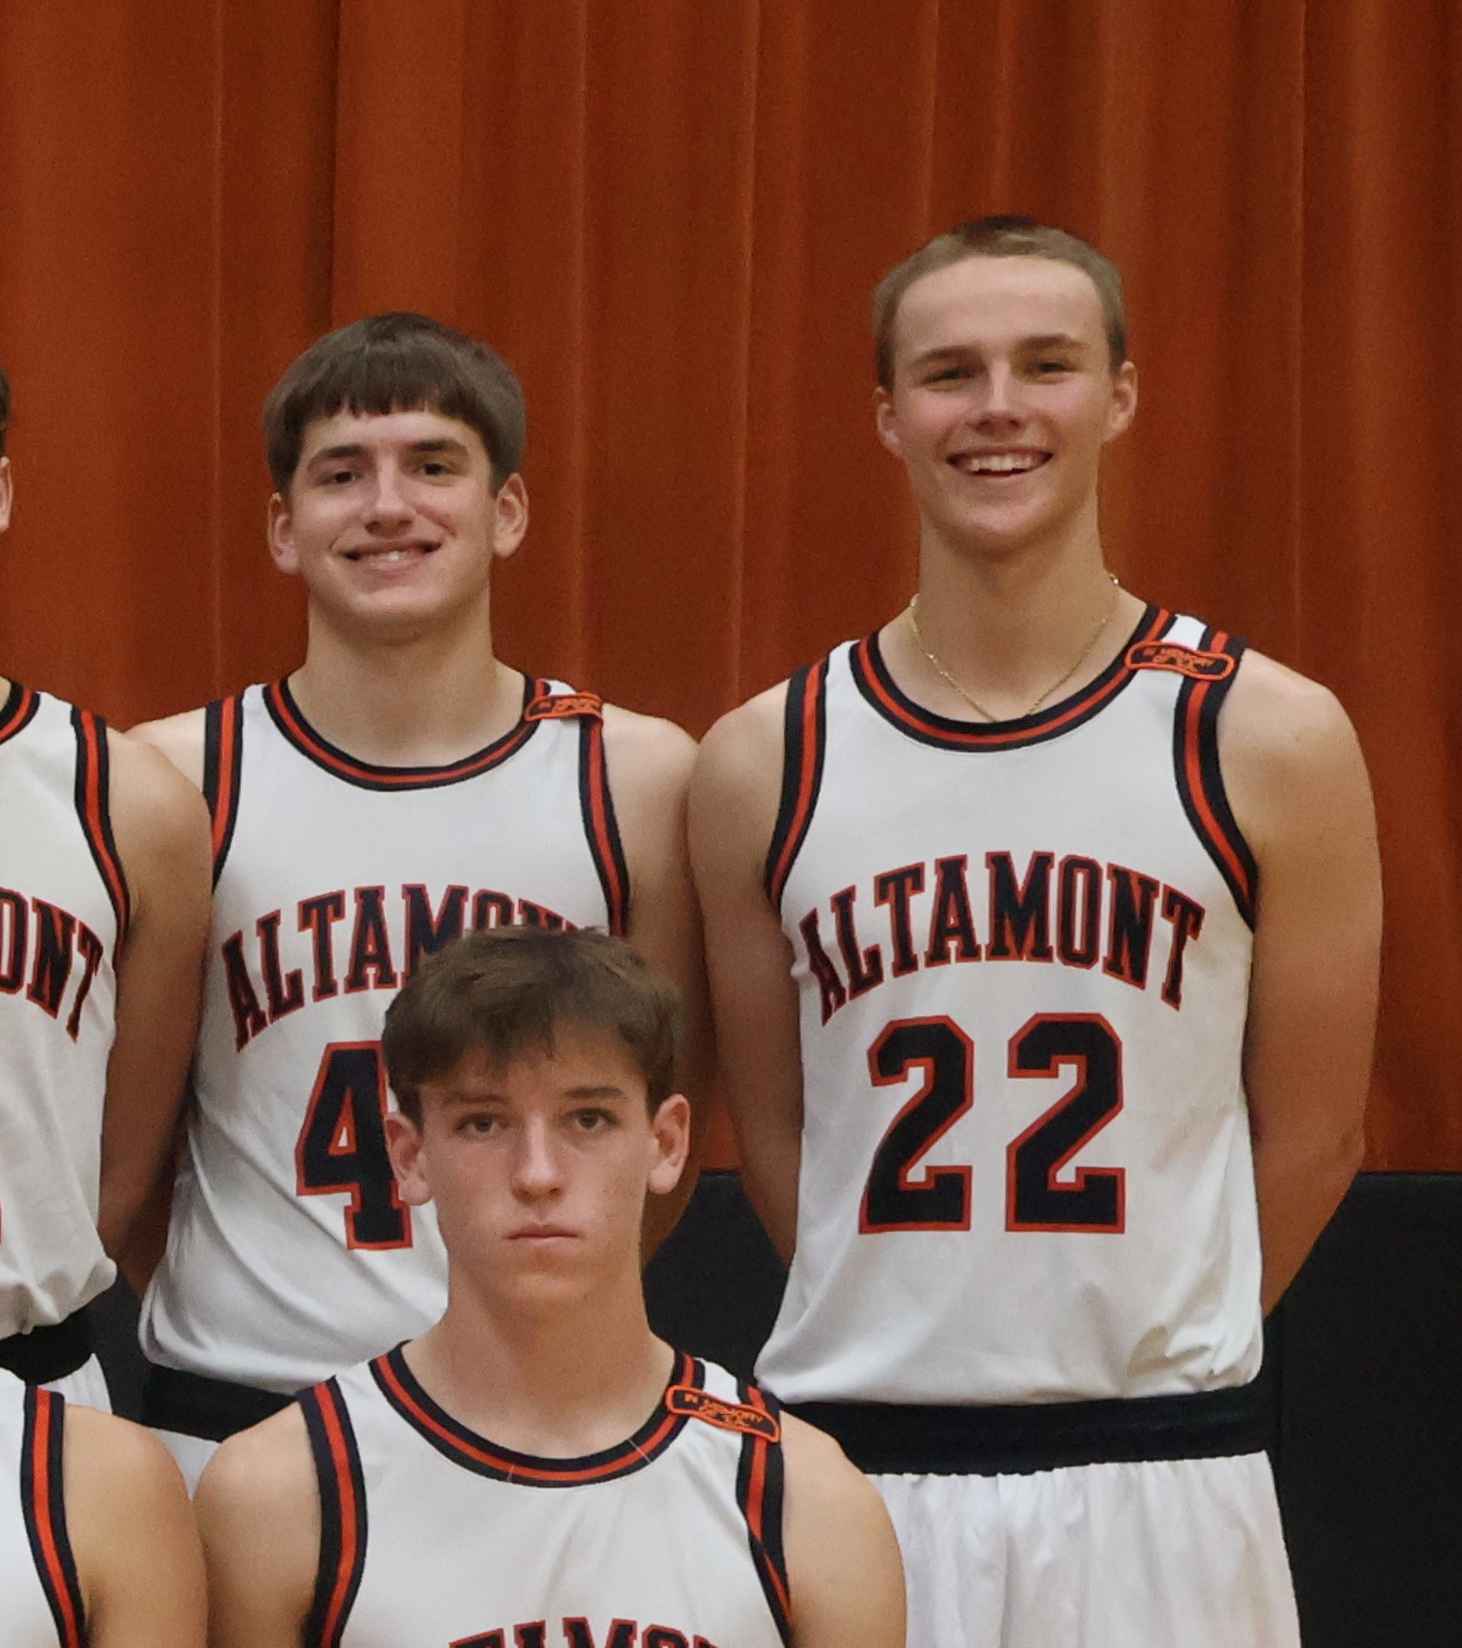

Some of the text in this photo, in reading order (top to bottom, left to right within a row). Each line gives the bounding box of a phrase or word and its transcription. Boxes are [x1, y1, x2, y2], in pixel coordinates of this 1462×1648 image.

[220, 884, 580, 1053] ALTAM
[799, 851, 1205, 1027] ALTAMONT
[858, 1012, 1126, 1234] 22
